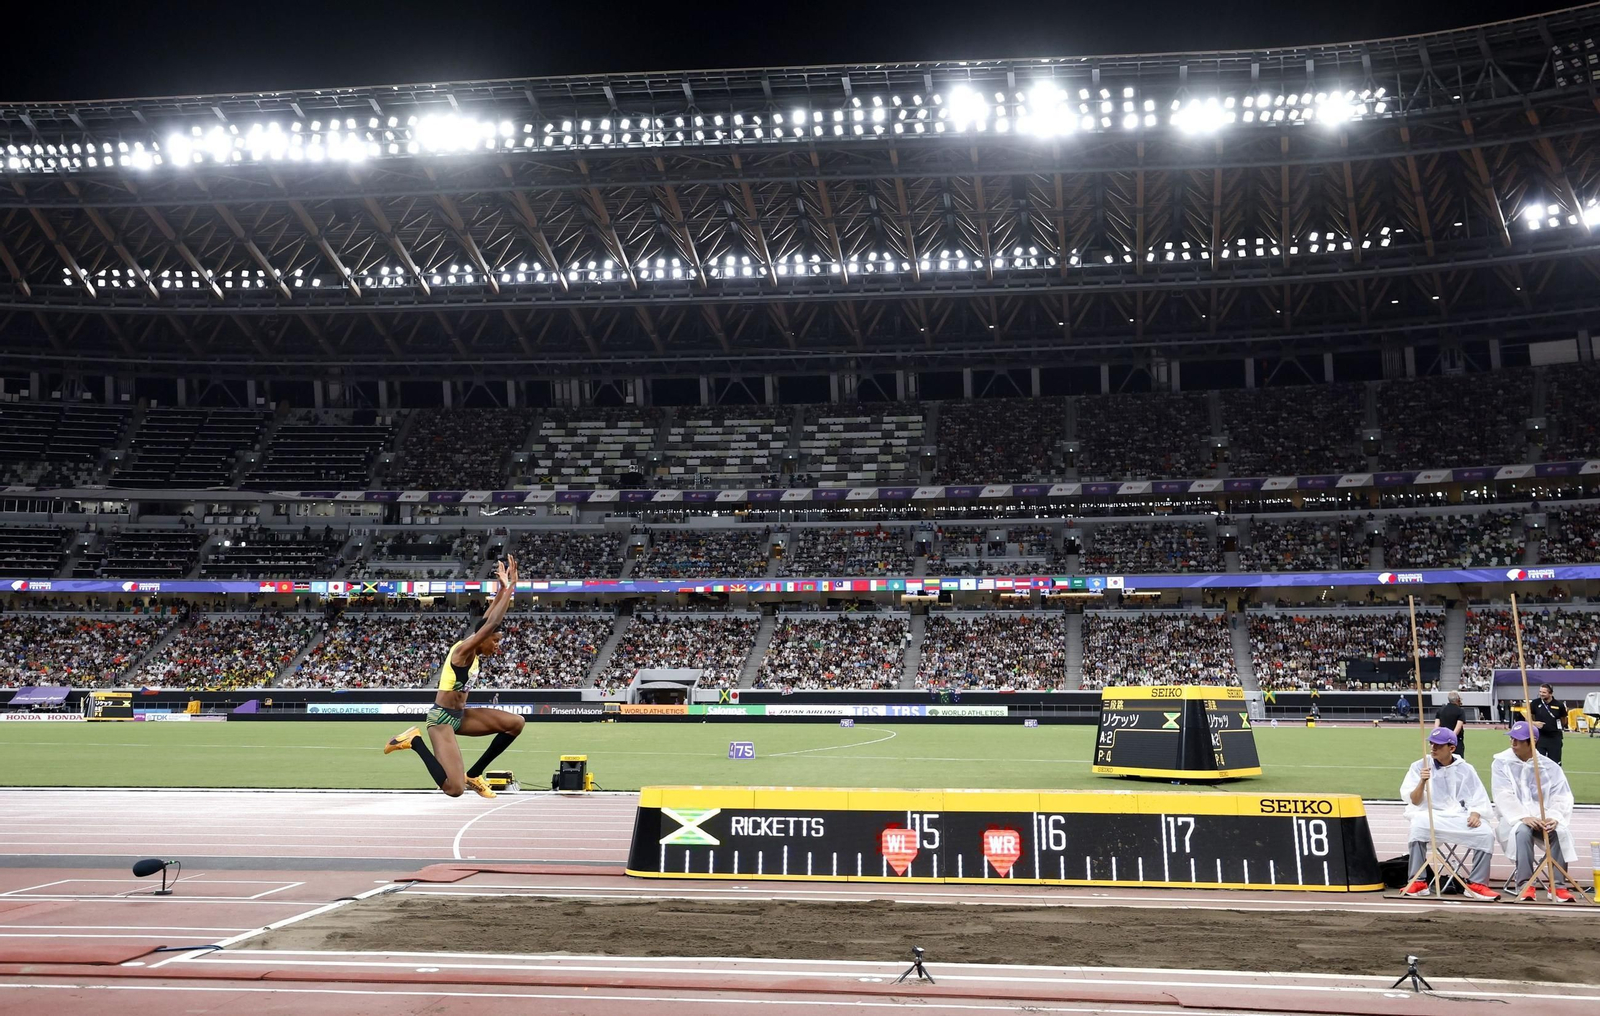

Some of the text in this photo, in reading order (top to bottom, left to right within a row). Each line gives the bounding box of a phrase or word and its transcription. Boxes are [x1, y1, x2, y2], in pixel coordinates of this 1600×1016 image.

[1151, 687, 1183, 698] SEIKO
[396, 704, 431, 714] Corpa
[480, 705, 532, 715] ONDO
[551, 707, 576, 715] Pinsent
[852, 706, 879, 716] TBS
[891, 706, 920, 716] TBS
[1102, 713, 1139, 727] リケッツ
[1100, 731, 1113, 743] A:2
[736, 745, 753, 757] 75
[1260, 799, 1333, 815] SEIKO
[731, 816, 825, 837] RICKETTS
[912, 813, 939, 849] 15
[1038, 815, 1066, 851] 16
[1167, 817, 1195, 853] 17
[1298, 819, 1329, 856] 18
[887, 834, 912, 853] WL
[988, 835, 1016, 854] WR
